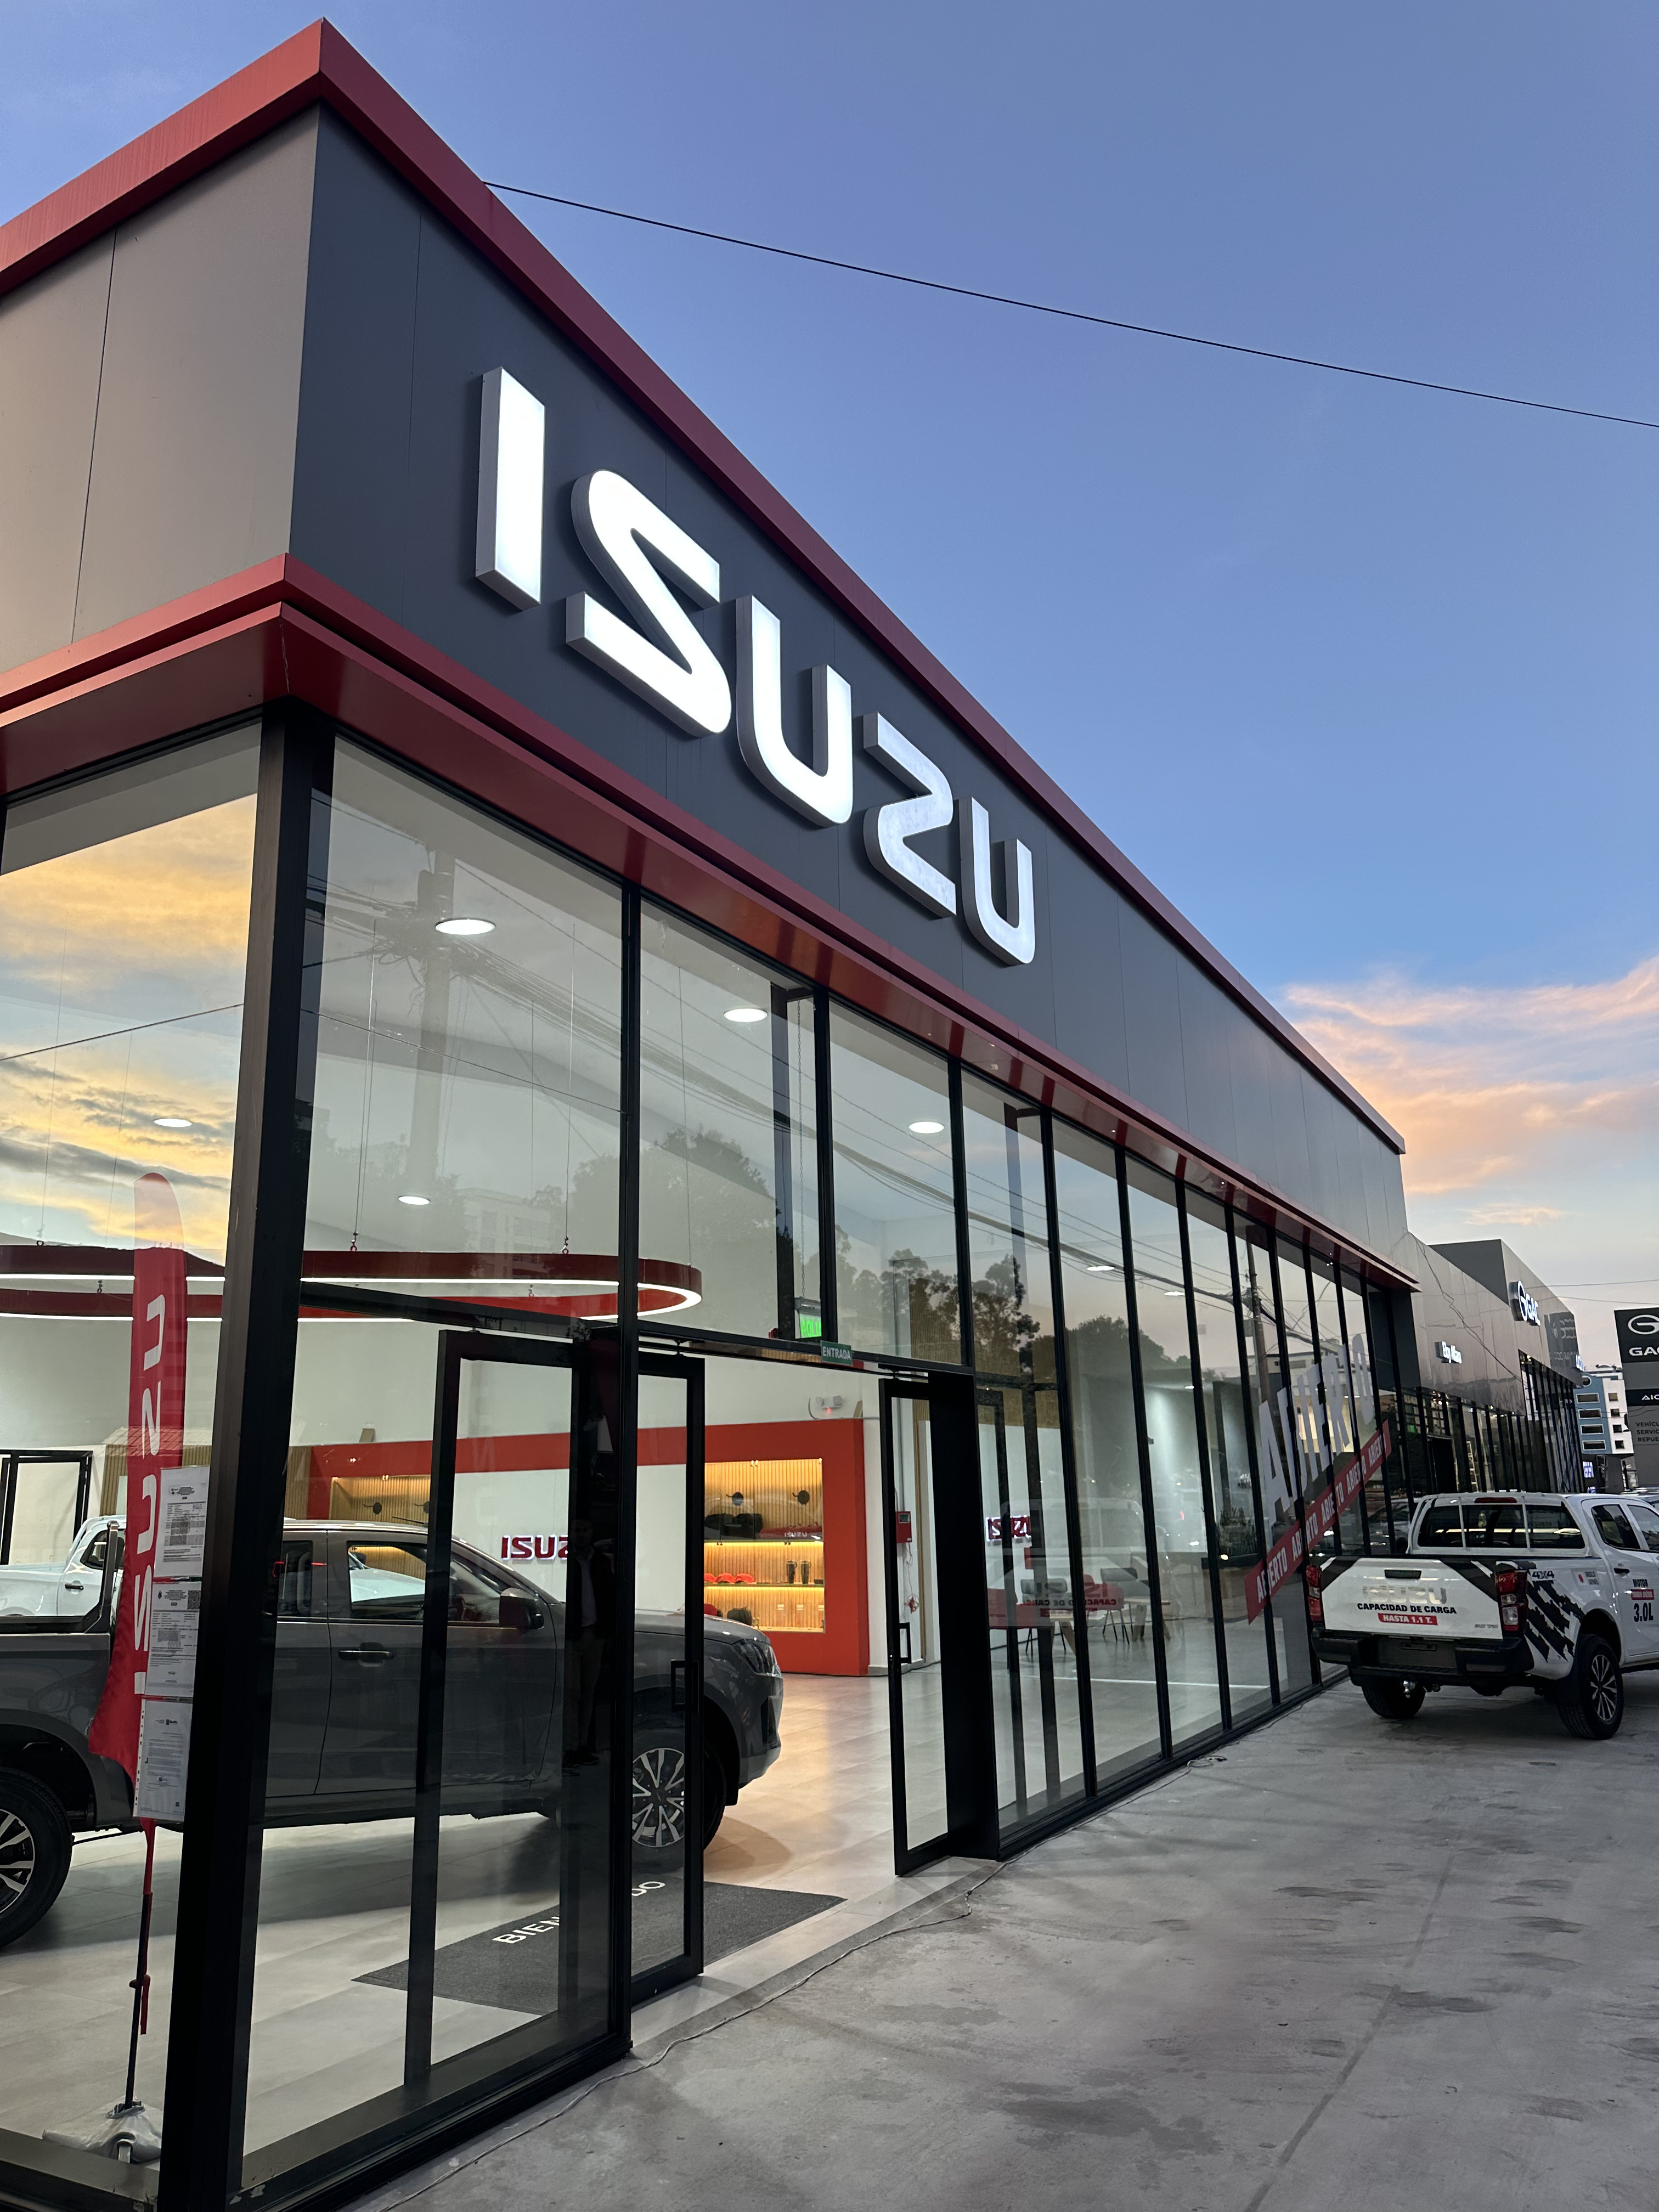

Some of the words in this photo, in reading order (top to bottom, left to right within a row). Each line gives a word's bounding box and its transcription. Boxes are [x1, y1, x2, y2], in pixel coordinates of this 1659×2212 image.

[476, 366, 1035, 965] ISUZU
[1526, 1293, 1541, 1326] GAC
[822, 1345, 852, 1361] ENTRADA
[134, 1294, 166, 1695] ISUZU
[1291, 1511, 1319, 1562] ABIRTO
[1321, 1481, 1345, 1527] ABIETO
[1346, 1454, 1367, 1496] ABIERO
[500, 1534, 568, 1560] ISU
[1632, 1578, 1649, 1588] MOTOR
[1357, 1602, 1408, 1612] CAPACIDAD
[1424, 1605, 1457, 1615] CARGA
[1383, 1614, 1410, 1623] HASTA
[1411, 1616, 1425, 1624] 1.1
[1425, 1616, 1433, 1624] T.
[1633, 1602, 1654, 1623] 3.0L
